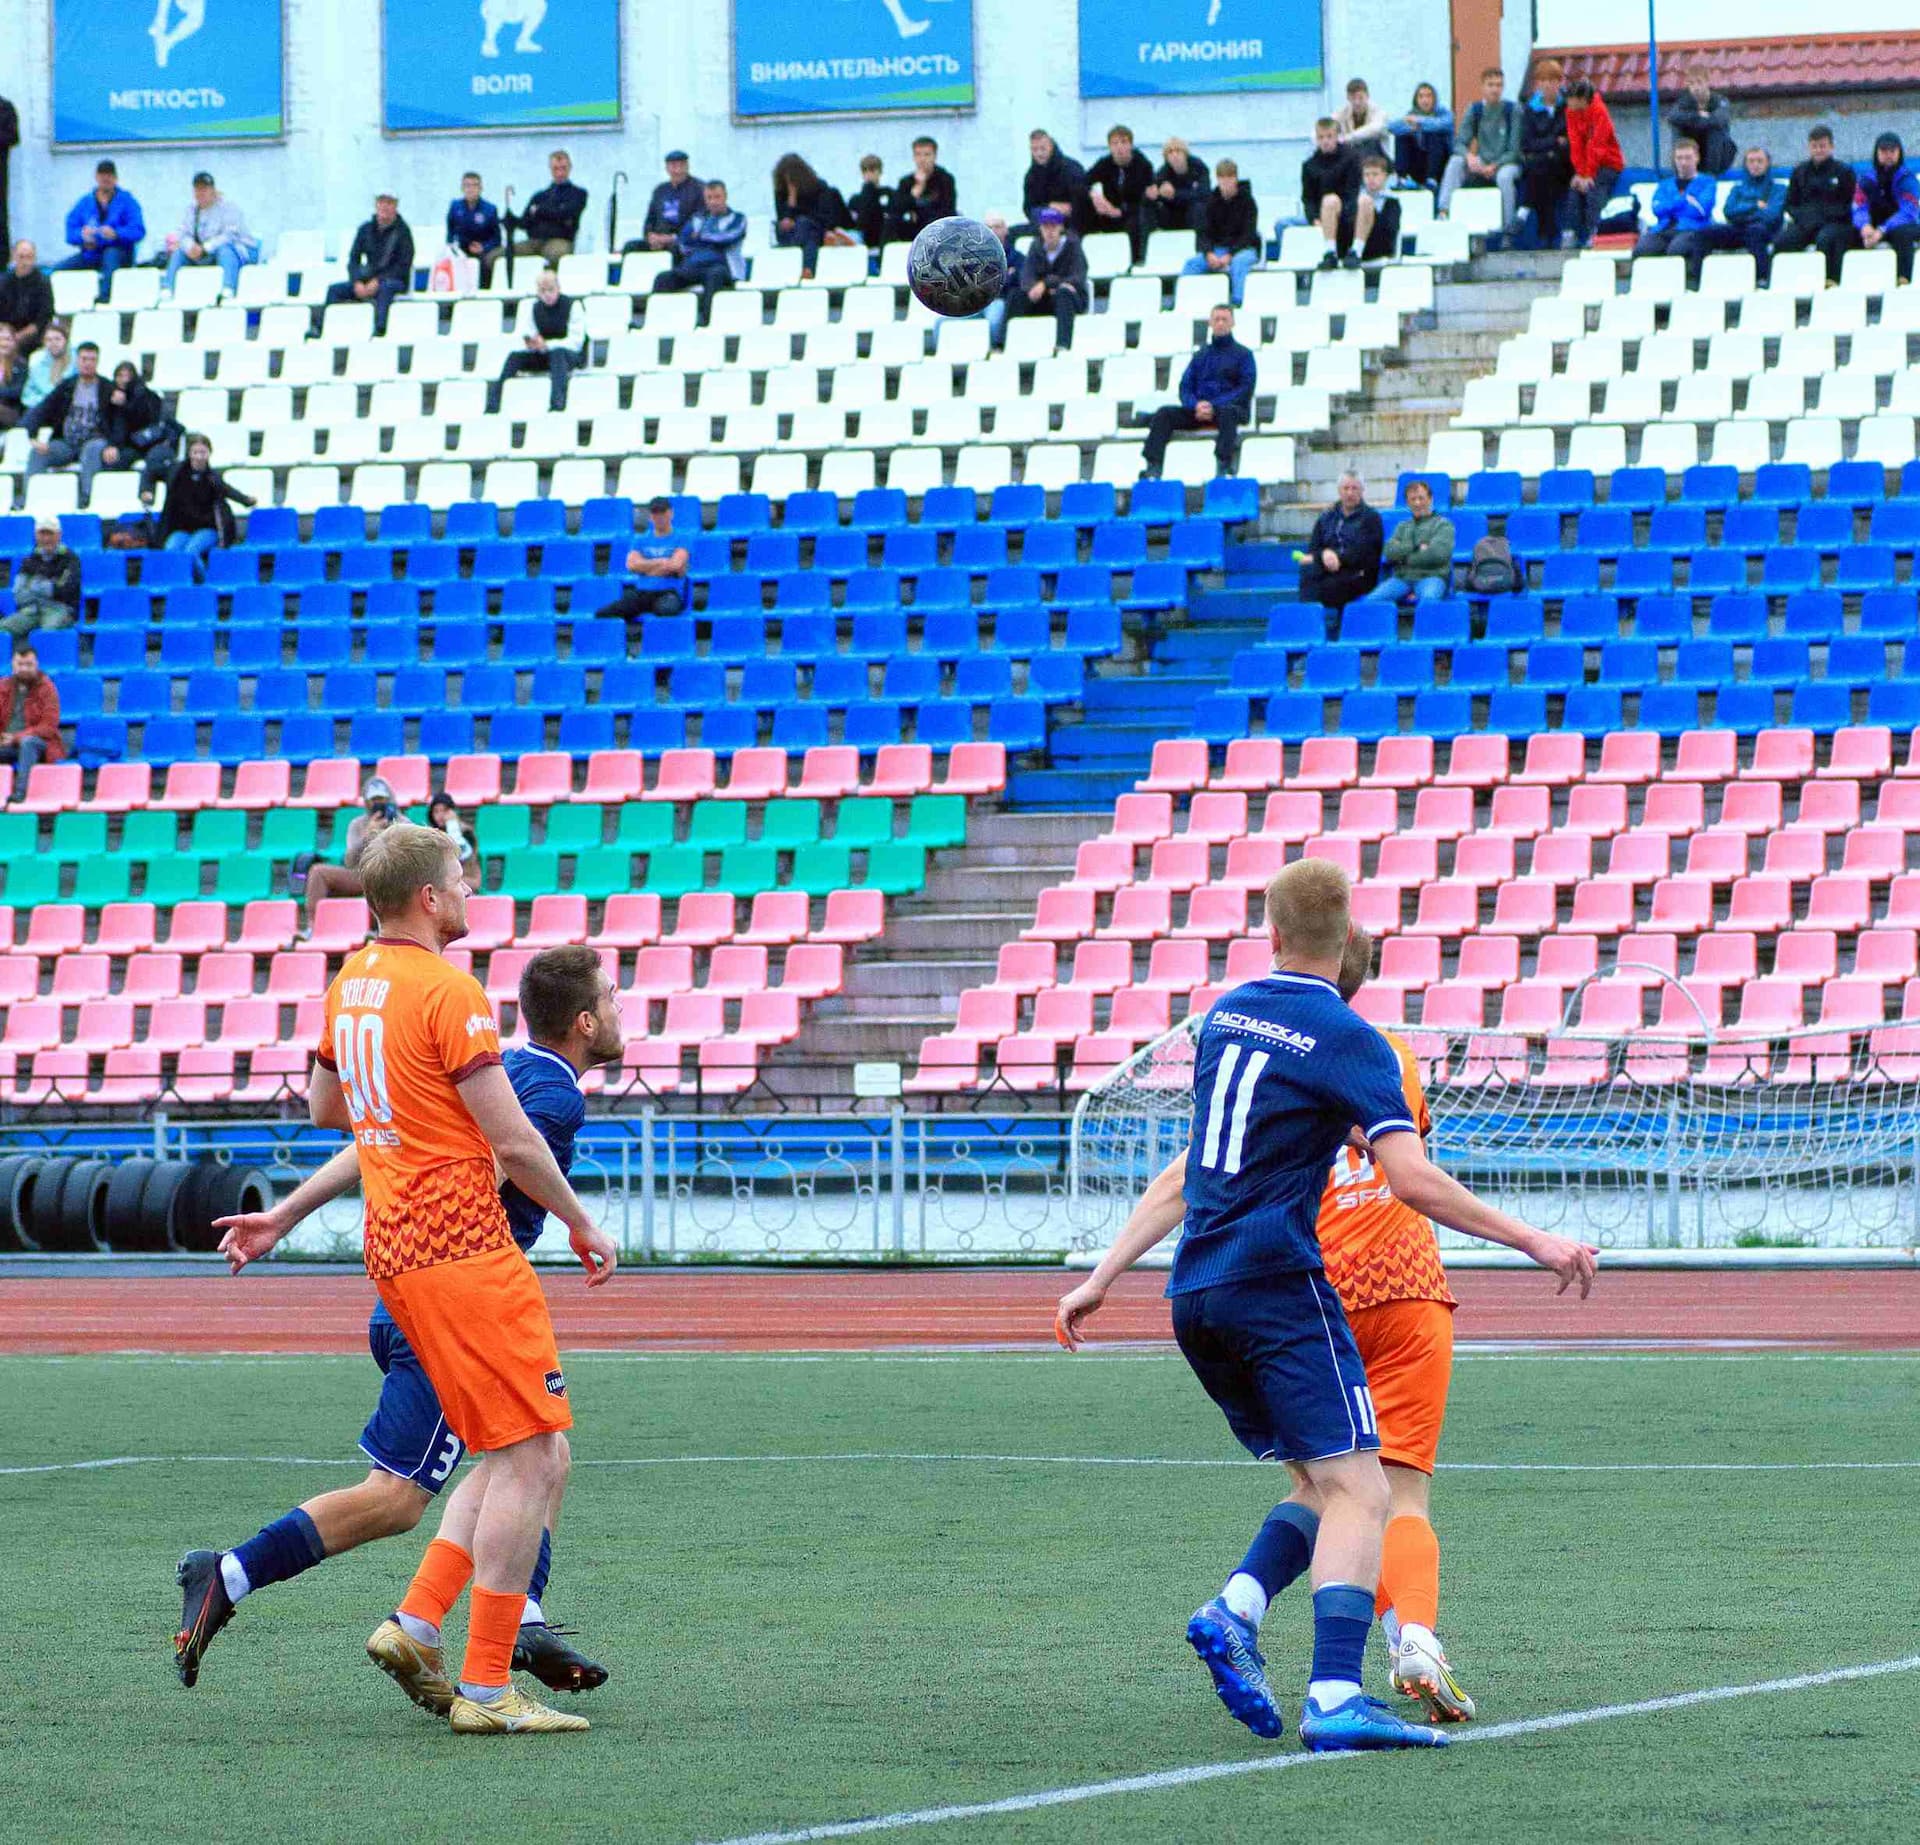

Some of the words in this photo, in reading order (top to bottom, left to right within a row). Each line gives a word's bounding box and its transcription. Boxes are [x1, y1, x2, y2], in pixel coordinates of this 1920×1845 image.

[750, 54, 960, 82] ВНИМАТЕЛЬНОСТЬ
[1138, 39, 1262, 63] ГАРМОНИЯ
[109, 88, 225, 110] МЕТКОСТЬ
[472, 74, 533, 96] ВОЛЯ
[335, 1013, 393, 1124] 90
[1200, 1043, 1271, 1174] 11
[1353, 1385, 1378, 1435] 11
[430, 1433, 460, 1482] 3
